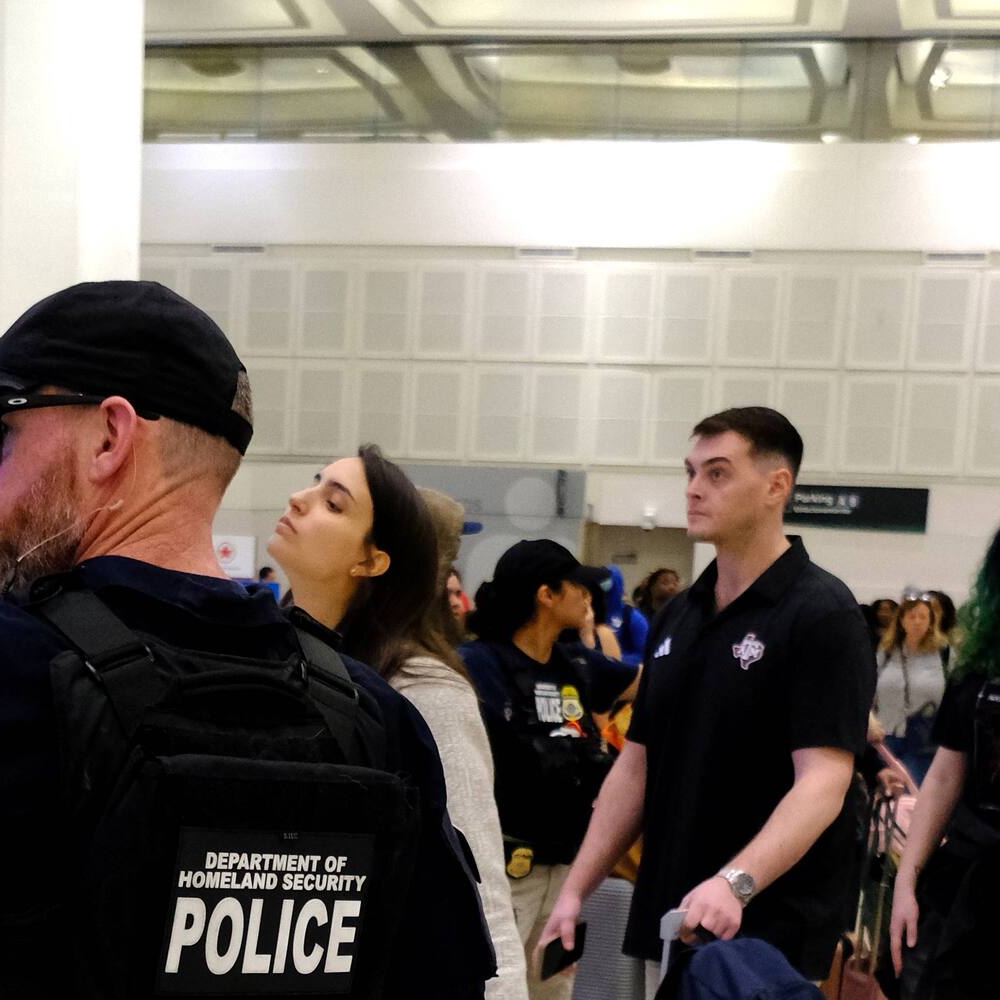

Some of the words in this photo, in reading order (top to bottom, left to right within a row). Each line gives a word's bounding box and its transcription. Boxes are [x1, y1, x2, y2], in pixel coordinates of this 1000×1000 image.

[205, 852, 321, 872] DEPARTMENT
[324, 856, 348, 872] OF
[178, 871, 278, 890] HOMELAND
[282, 874, 367, 892] SECURITY
[165, 896, 362, 975] POLICE
